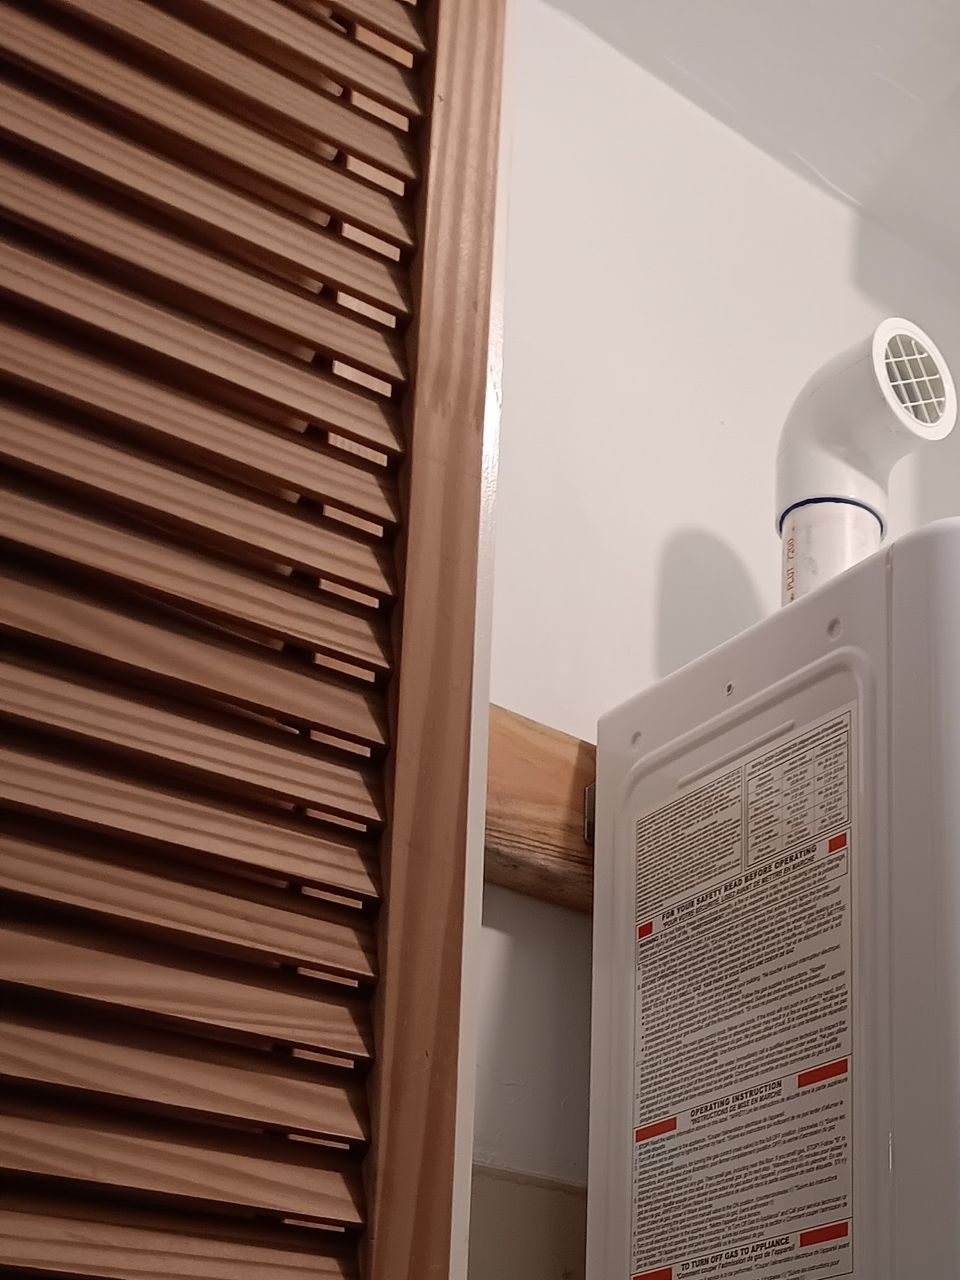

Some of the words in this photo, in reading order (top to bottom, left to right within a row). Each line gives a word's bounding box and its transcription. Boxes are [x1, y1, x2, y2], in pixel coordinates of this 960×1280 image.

[662, 909, 674, 921] FOR
[676, 900, 693, 914] YOUR
[696, 887, 721, 905] SAFETY
[724, 878, 742, 893] READ
[744, 864, 772, 883] BEFORE
[775, 843, 816, 869] OPERATING
[690, 1097, 730, 1117] OPERATING
[732, 1079, 781, 1103] INSTRUCTION
[729, 1104, 735, 1112] DE
[737, 1099, 749, 1110] MISE
[751, 1096, 757, 1105] EN
[759, 1088, 781, 1102] MARCHE
[681, 1262, 689, 1271] TO
[691, 1257, 708, 1268] TURN
[711, 1253, 722, 1263] OFF
[725, 1249, 738, 1260] GAS
[740, 1246, 749, 1256] TO
[751, 1236, 789, 1253] APPLIANCE
